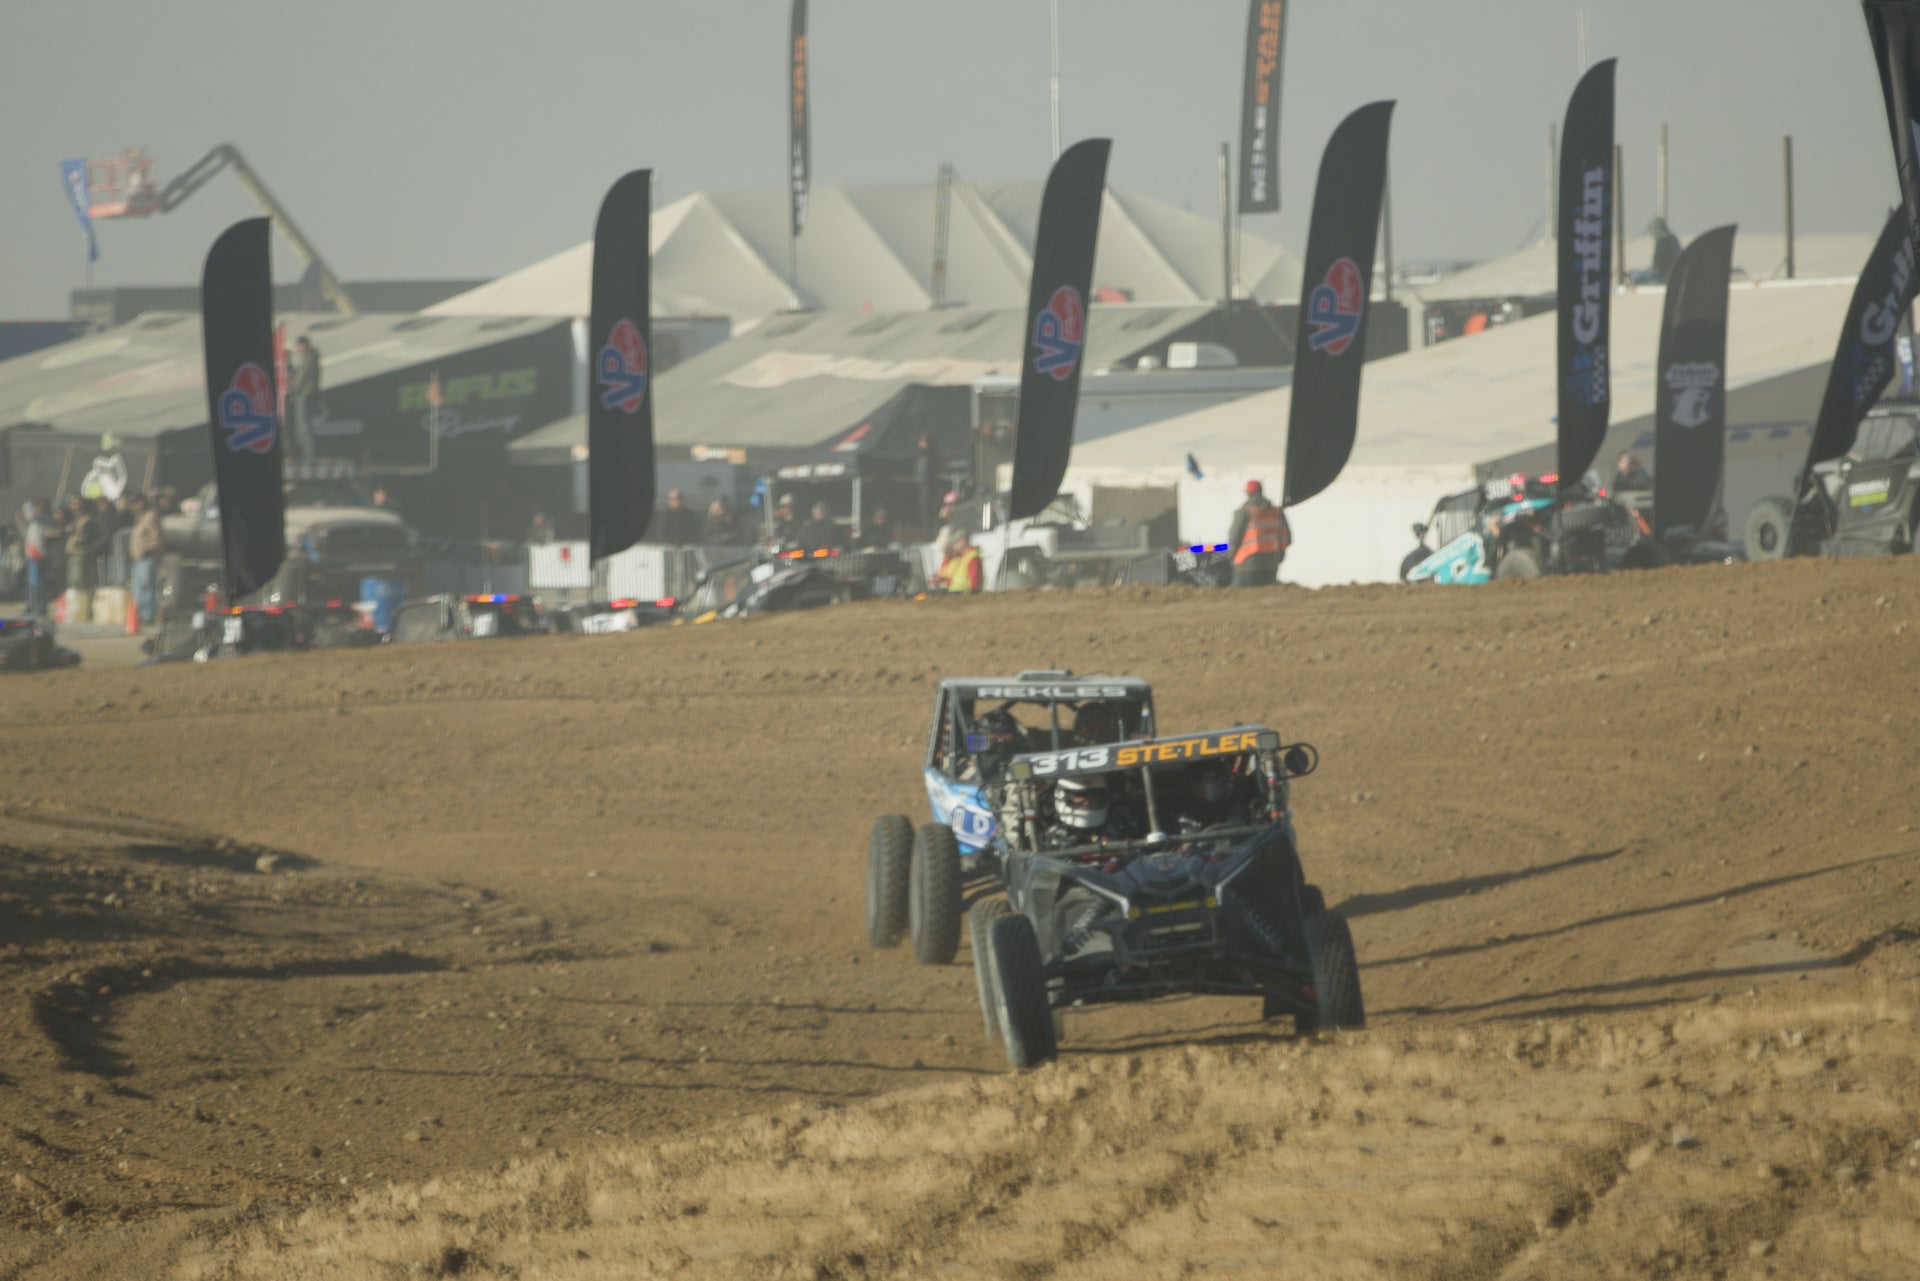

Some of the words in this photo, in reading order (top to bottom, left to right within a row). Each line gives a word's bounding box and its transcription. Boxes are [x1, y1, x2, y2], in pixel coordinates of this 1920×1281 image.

[1573, 166, 1604, 345] Griffin
[1307, 283, 1361, 352] VP
[1860, 236, 1916, 347] Griff
[1032, 309, 1082, 373] VP
[596, 345, 646, 410] VP
[218, 388, 276, 452] VP
[977, 686, 1127, 698] REKLES
[1029, 747, 1109, 776] 313
[1115, 731, 1258, 767] STETLER
